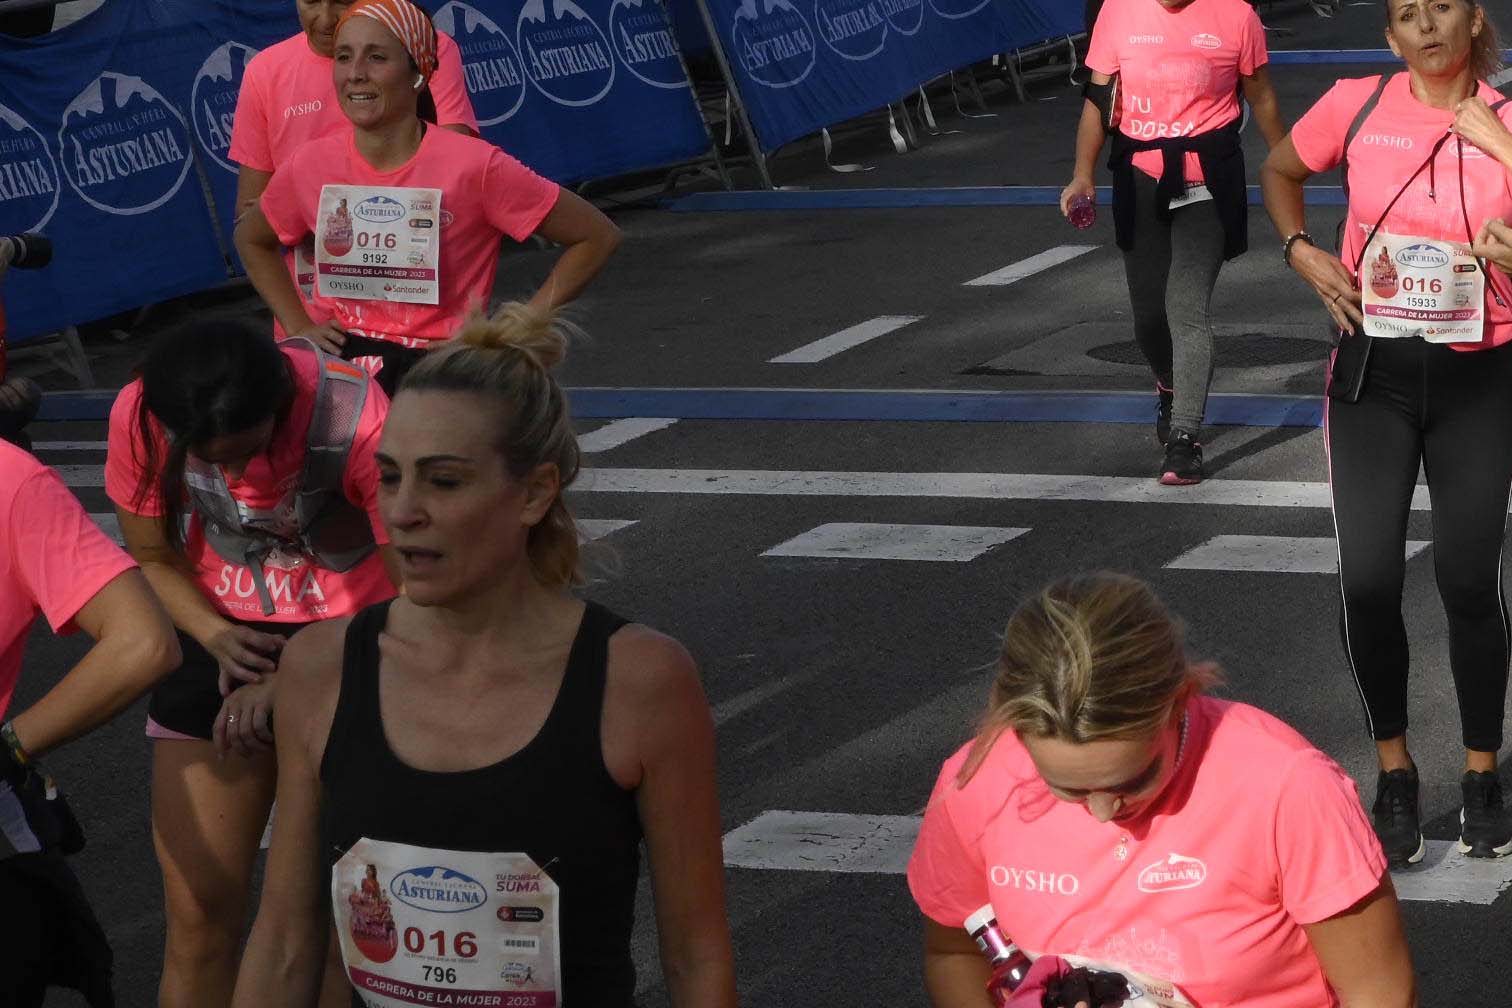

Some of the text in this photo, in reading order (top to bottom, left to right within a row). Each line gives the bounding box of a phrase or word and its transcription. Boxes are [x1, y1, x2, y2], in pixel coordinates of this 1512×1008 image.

[526, 35, 611, 81] ASTURIANA
[284, 100, 322, 120] OYSHO
[1362, 134, 1413, 150] OYSHO
[71, 126, 184, 188] ASTURIANA
[357, 205, 401, 217] ASTURIANA
[357, 231, 397, 249] 016
[362, 253, 388, 264] 9192
[1400, 250, 1446, 264] ASTURIANA
[330, 266, 426, 278] CARRERA DE LA MUJER 2023
[329, 281, 430, 295] OYSHO Santander
[1402, 276, 1443, 294] 016
[1407, 296, 1437, 308] 15933
[1376, 308, 1407, 318] CARRERA
[1408, 310, 1417, 318] DE
[1418, 311, 1428, 319] LA
[1429, 311, 1453, 320] MUJER
[1374, 321, 1474, 335] OYSHO Santander
[214, 564, 325, 602] SUMA
[496, 881, 541, 893] SUMA
[990, 865, 1080, 896] OYSHO
[398, 878, 480, 904] ASTURIANA
[403, 926, 478, 958] 016
[422, 965, 457, 984] 796
[366, 977, 537, 1007] CARRERA DE LA MUJER 2023
